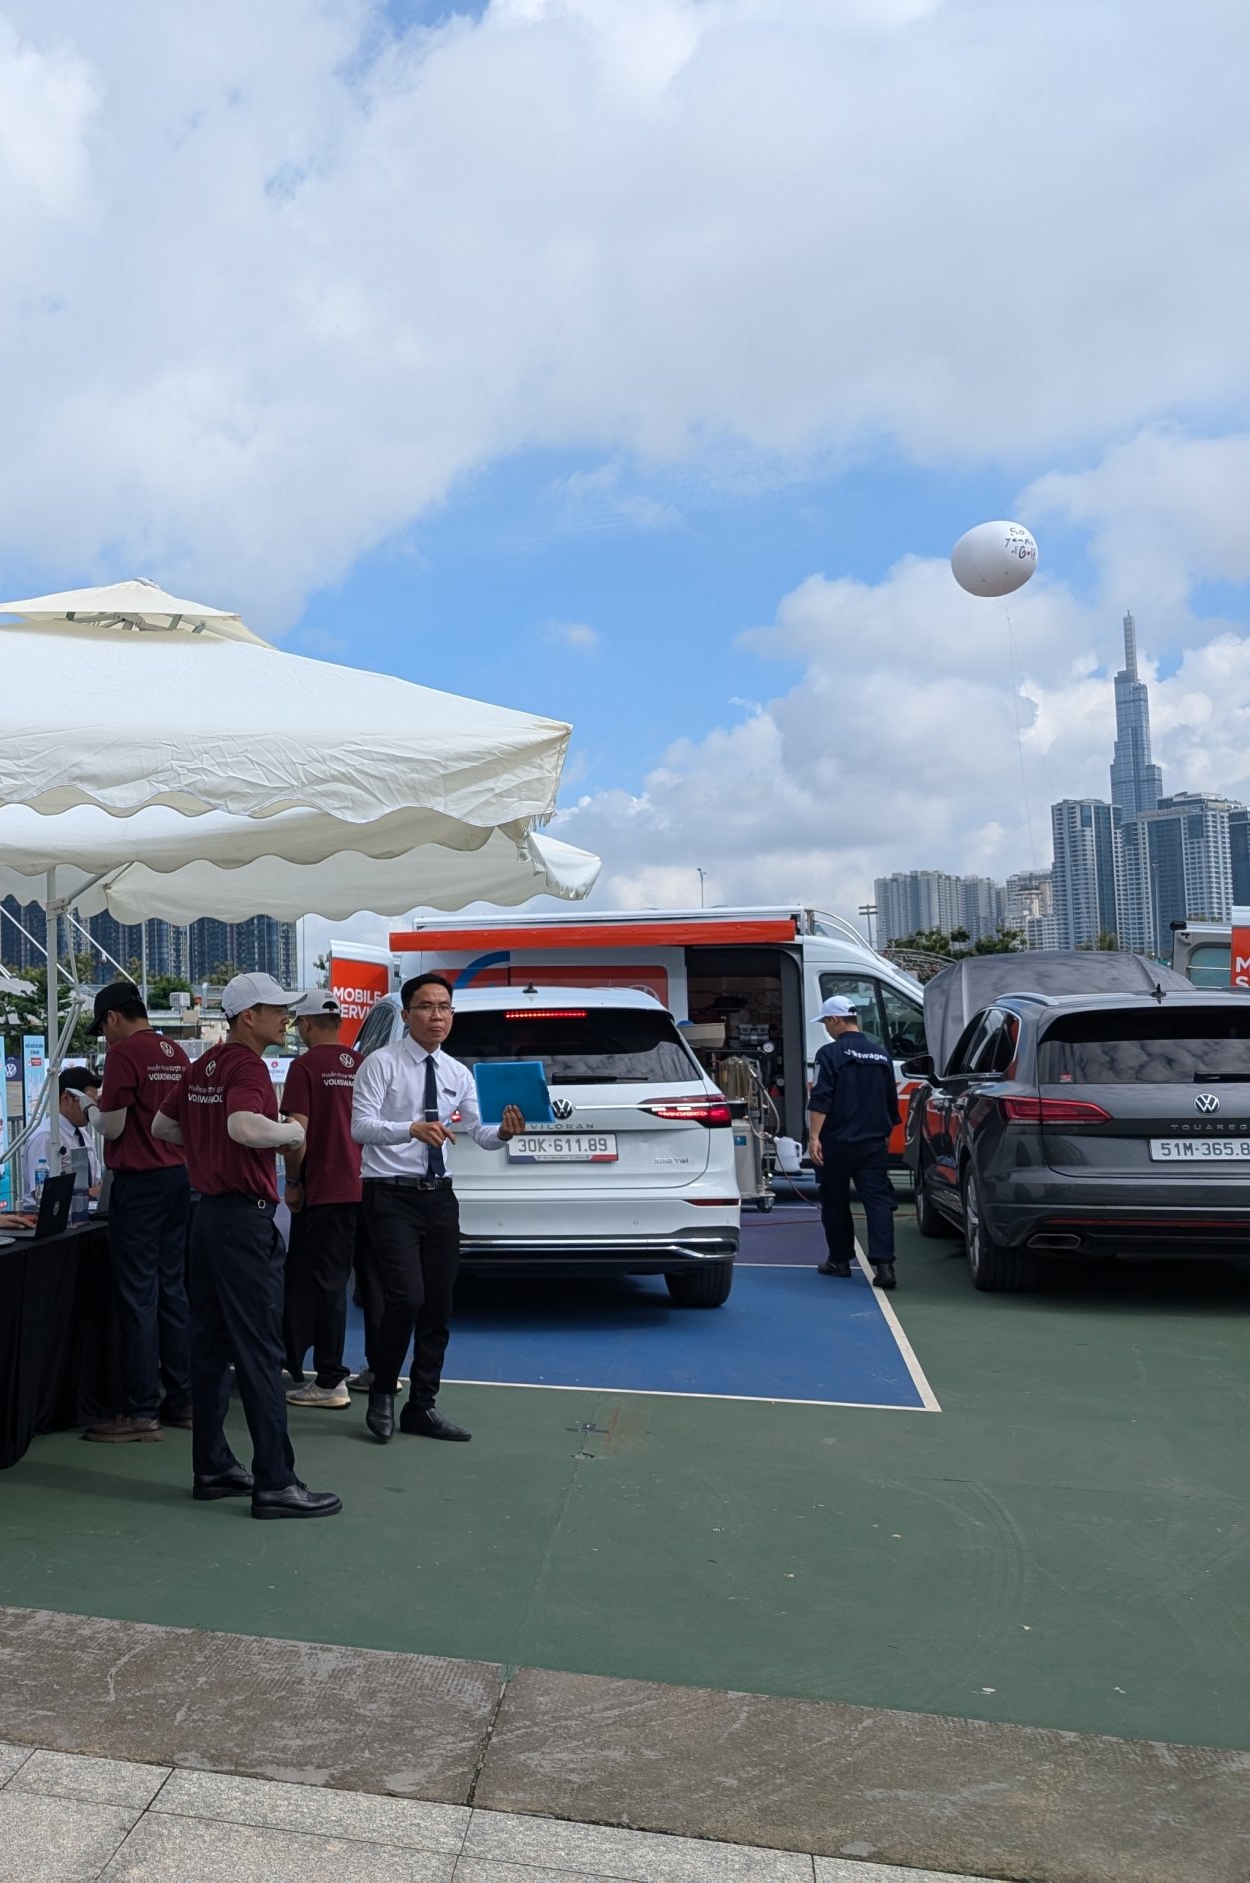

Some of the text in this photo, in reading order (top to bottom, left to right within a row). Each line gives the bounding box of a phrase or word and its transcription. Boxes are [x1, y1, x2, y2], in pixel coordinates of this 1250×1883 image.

[333, 986, 382, 1005] MOBILE
[340, 1003, 370, 1020] ERVI
[518, 1138, 608, 1153] 30K-611.89
[1160, 1142, 1250, 1156] 51M-365.8
